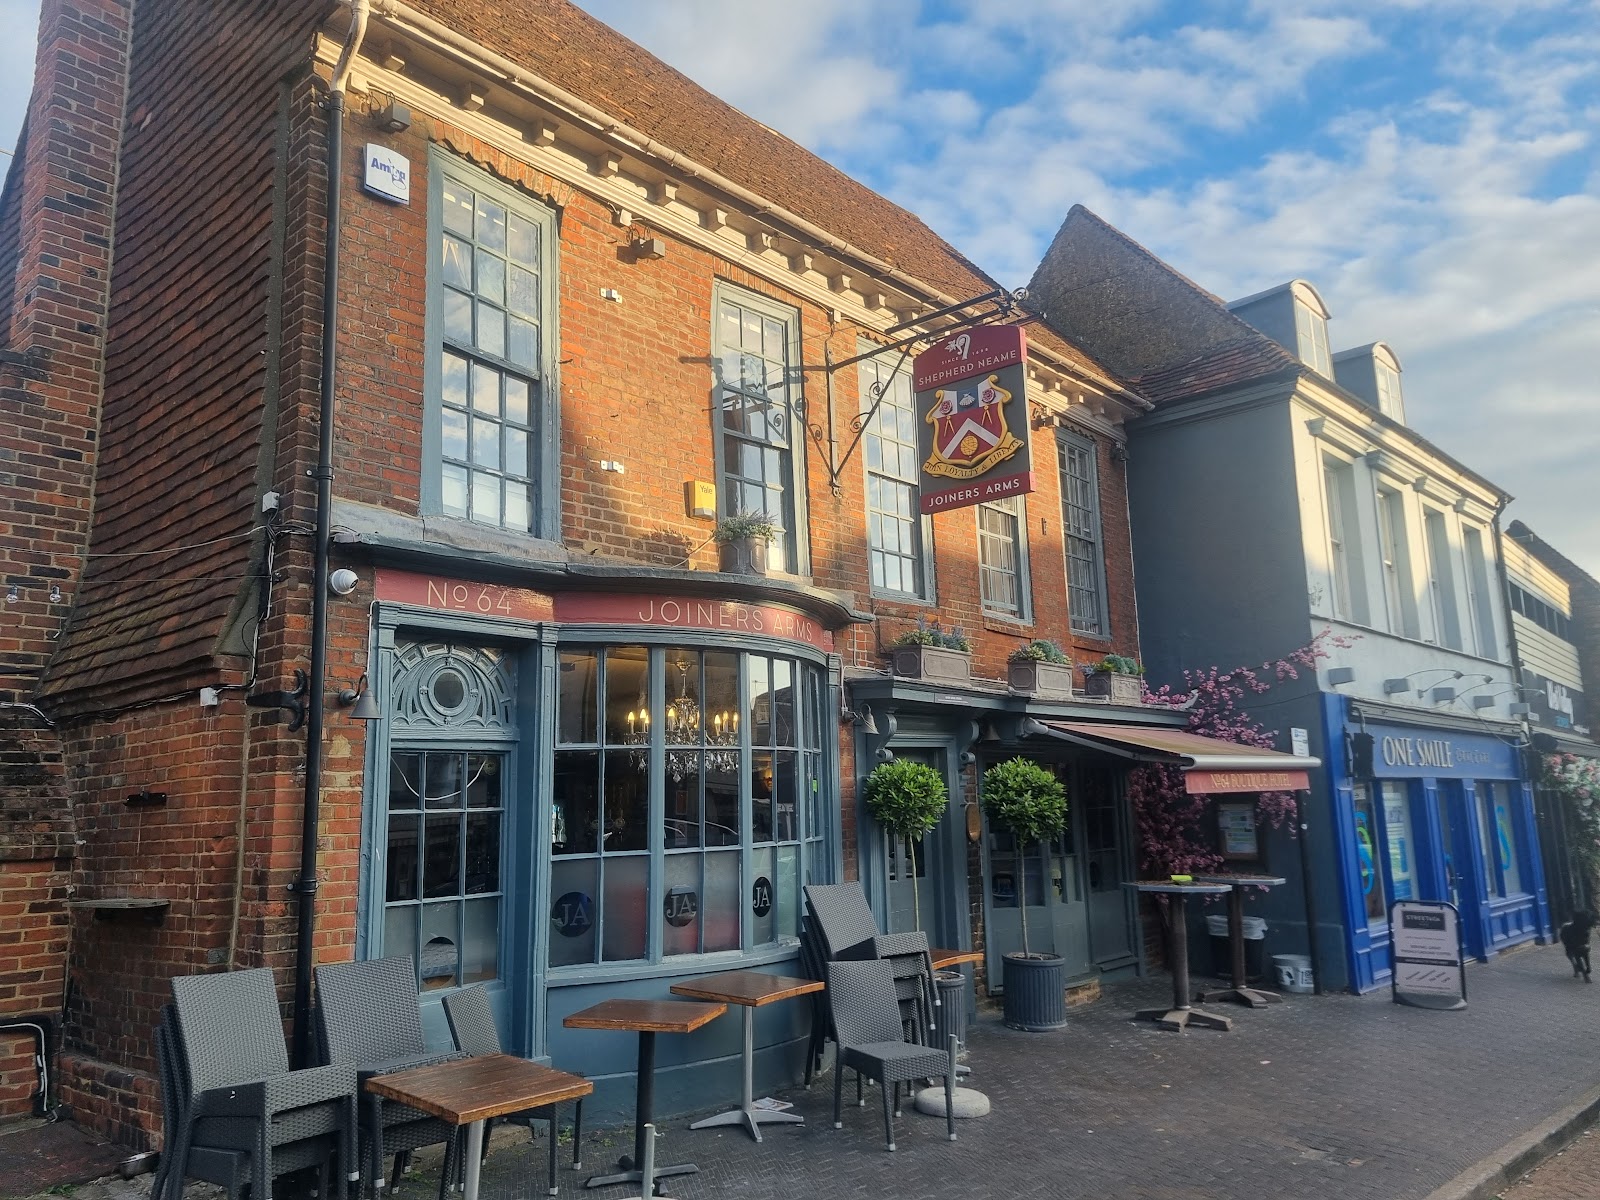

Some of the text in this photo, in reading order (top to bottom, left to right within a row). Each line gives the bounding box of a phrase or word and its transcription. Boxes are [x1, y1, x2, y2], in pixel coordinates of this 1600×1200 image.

[918, 349, 1017, 386] SHEPHERD NEAME
[941, 356, 959, 365] SINCE
[944, 466, 980, 477] LOYALTY
[981, 464, 988, 472] &
[699, 484, 713, 494] Yale
[929, 478, 1020, 507] JOINERS ARMS
[477, 588, 512, 614] 64
[638, 600, 763, 632] JOINERS
[772, 613, 812, 642] ARMS
[1383, 736, 1415, 766] ONE
[1416, 739, 1453, 768] SMILE
[666, 894, 696, 918] JA
[753, 886, 771, 908] JA
[560, 902, 591, 927] JA
